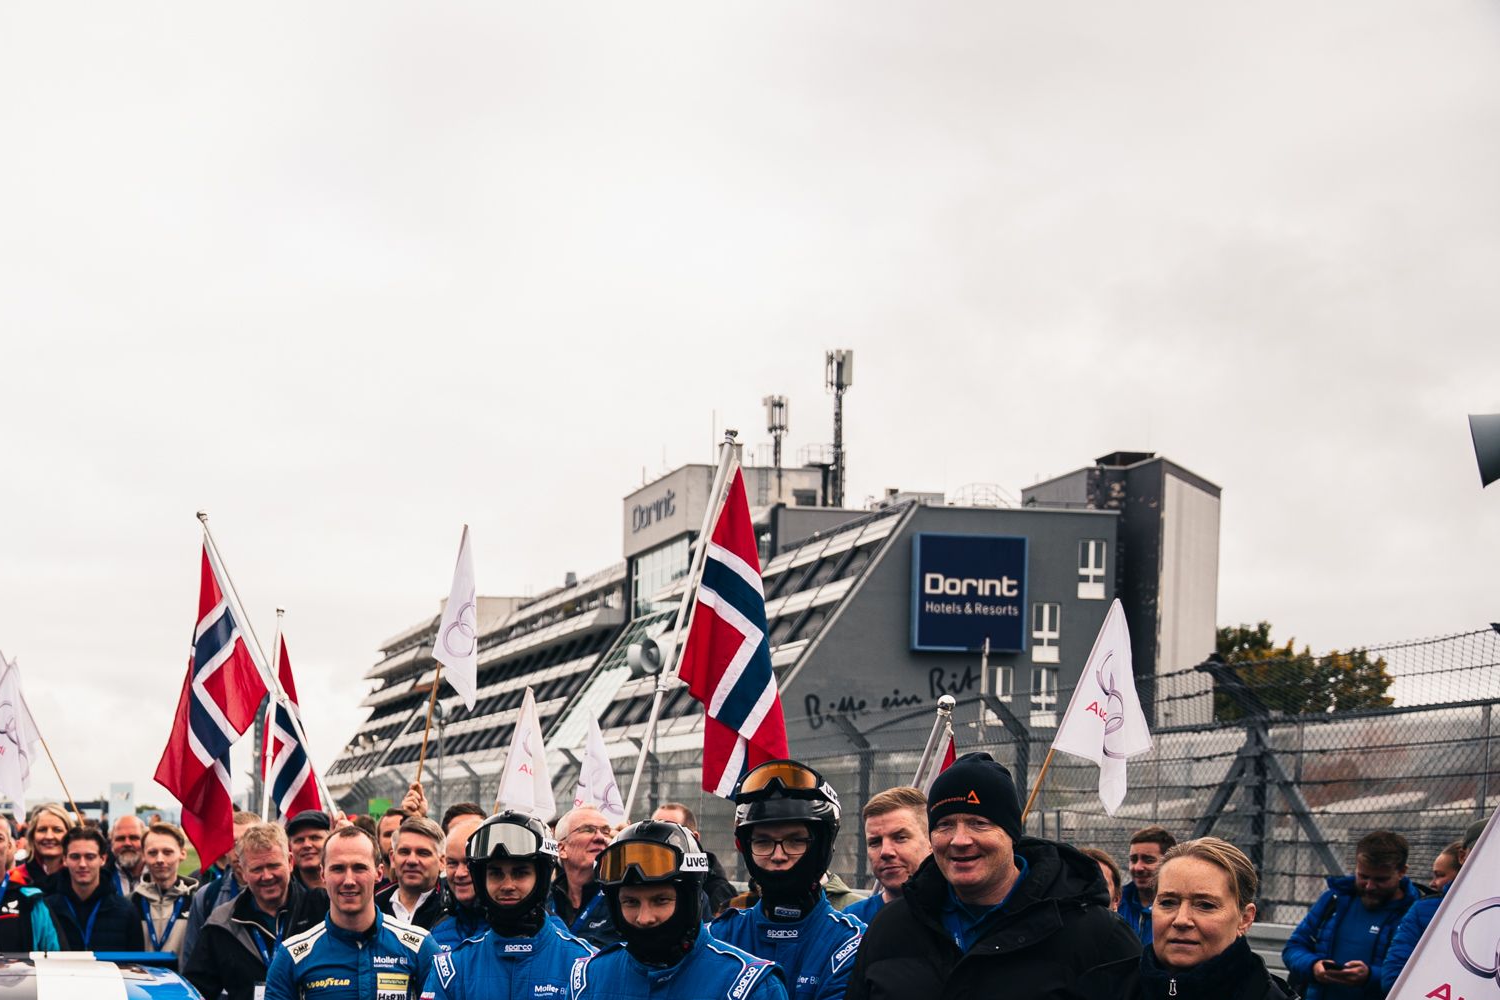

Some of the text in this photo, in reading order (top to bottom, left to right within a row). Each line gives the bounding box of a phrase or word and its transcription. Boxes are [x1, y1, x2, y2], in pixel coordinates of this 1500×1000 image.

[924, 572, 1019, 597] Dorint
[925, 601, 1019, 616] Hotels & Resorts
[767, 929, 799, 938] sparco
[732, 965, 758, 999] sparco
